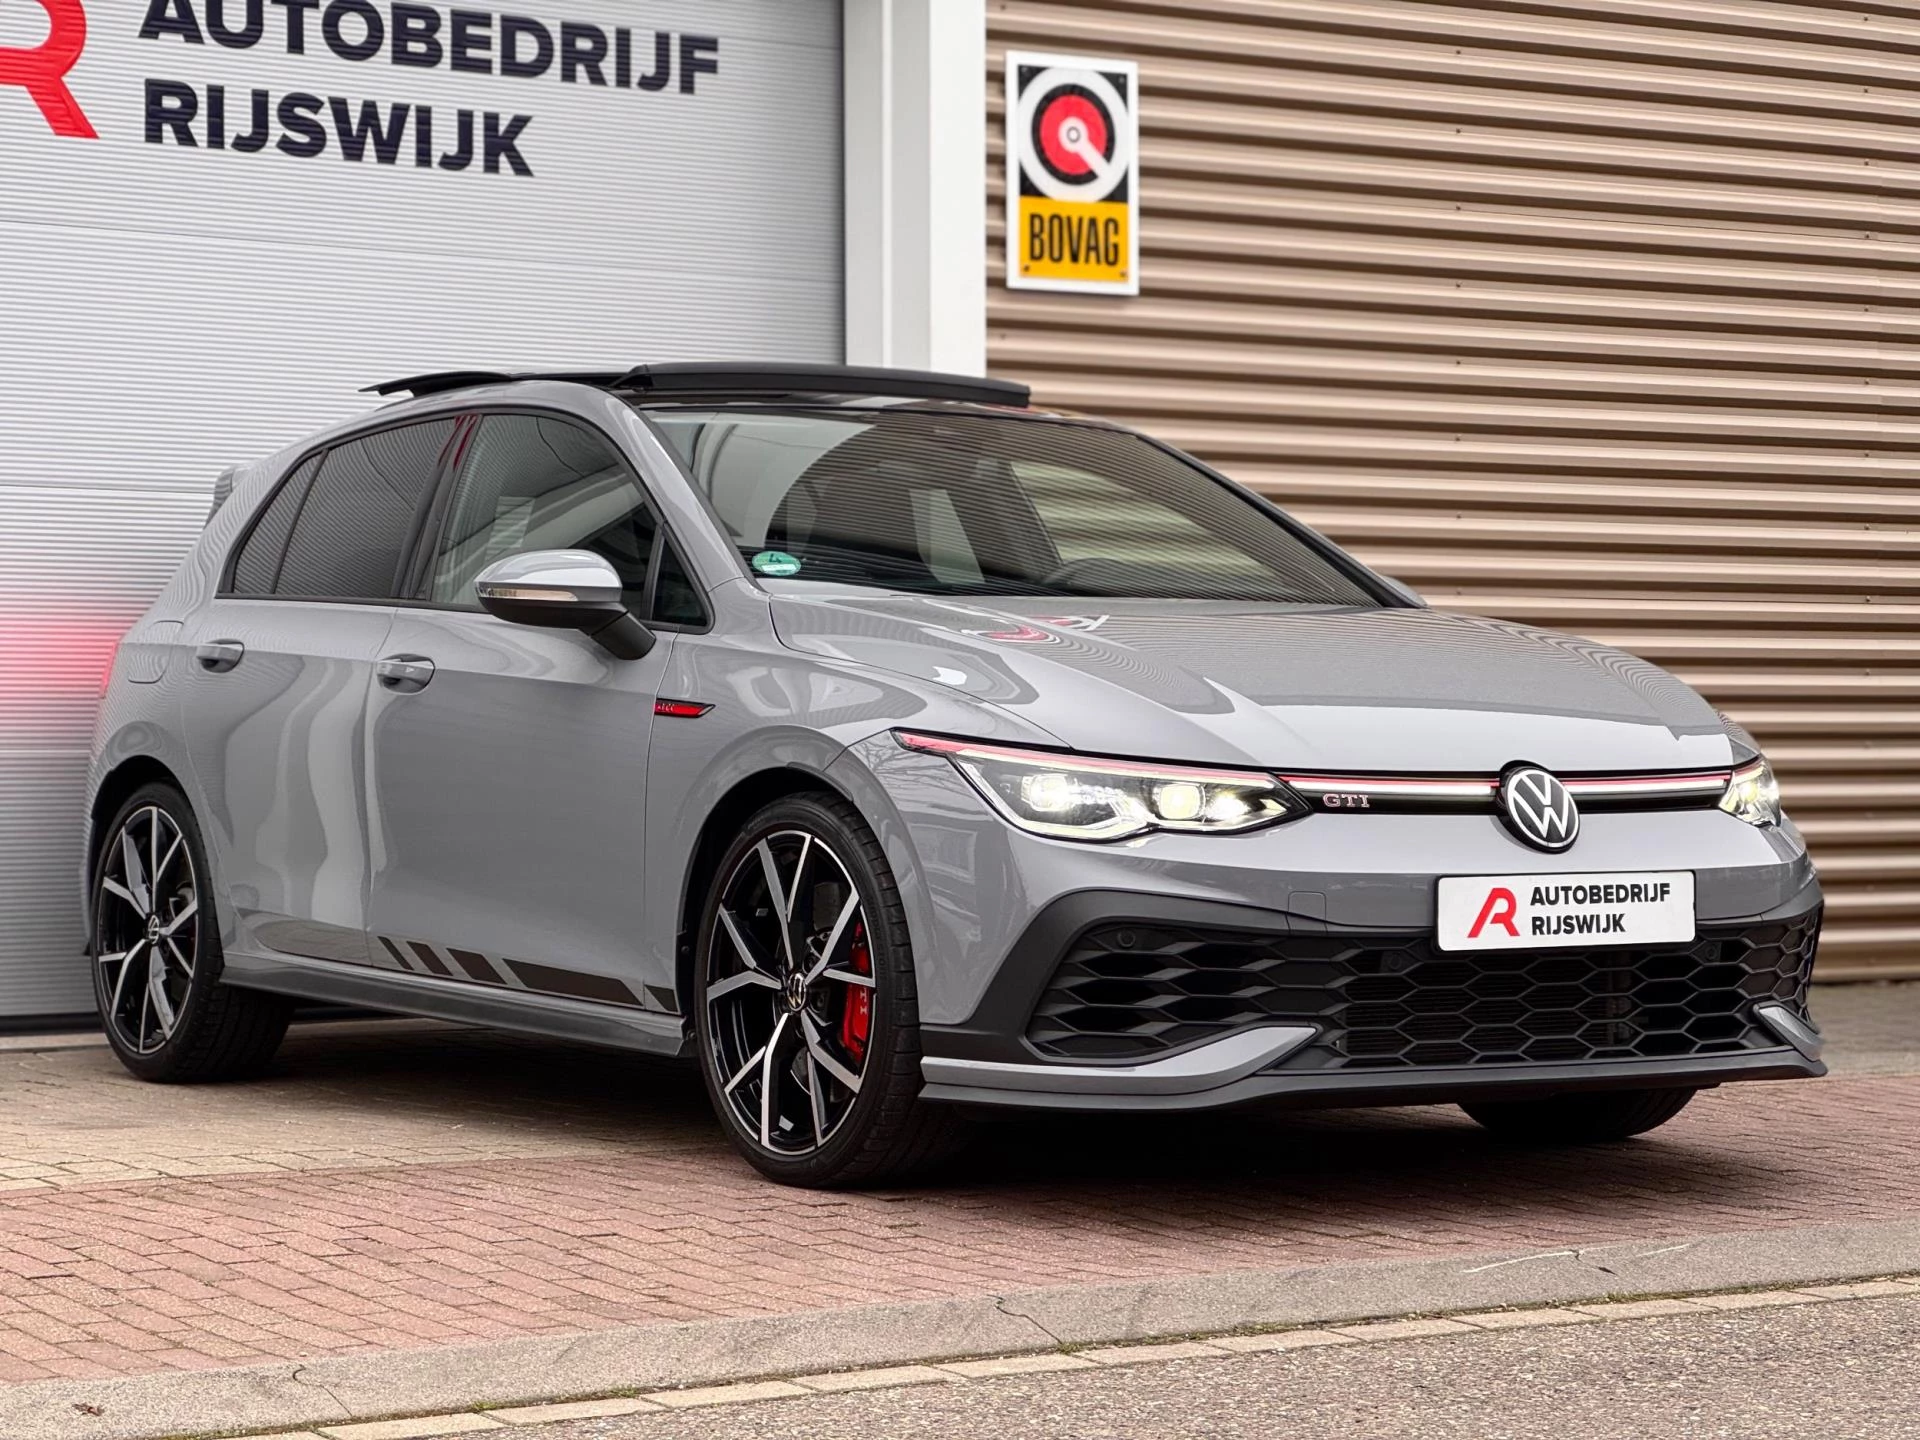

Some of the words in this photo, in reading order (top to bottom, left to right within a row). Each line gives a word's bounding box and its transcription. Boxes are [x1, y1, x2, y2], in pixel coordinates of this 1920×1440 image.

[138, 0, 719, 95] AUTOBEDRIJF
[144, 78, 535, 177] RIJSWIJK
[1029, 213, 1119, 267] BOVAG
[1323, 794, 1370, 808] GTI
[1530, 883, 1670, 906] AUTOBEDRIJF
[1531, 913, 1626, 936] RIJSWIJK
